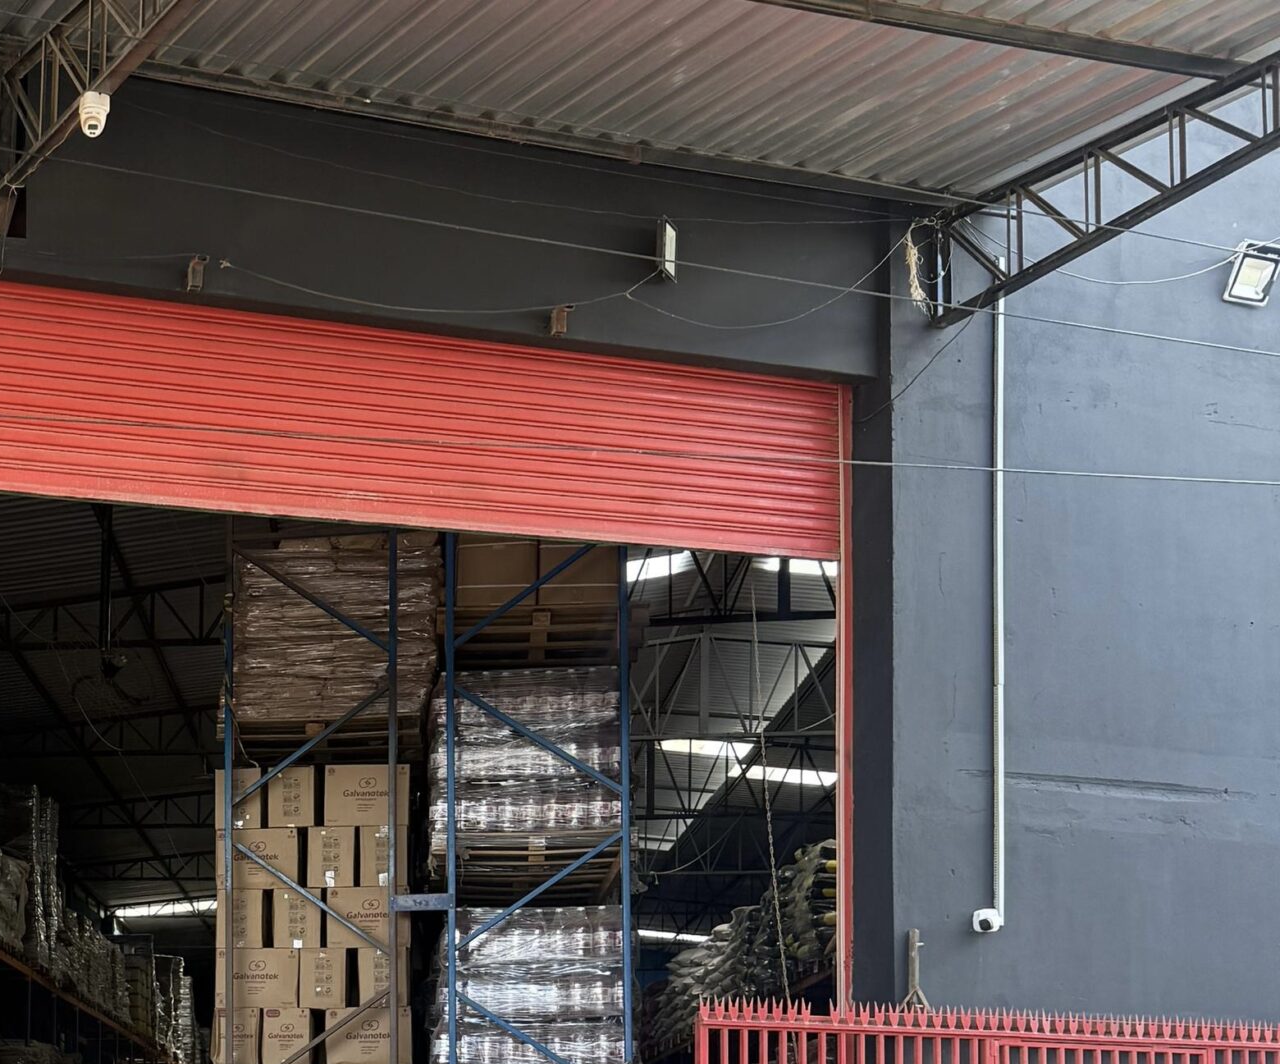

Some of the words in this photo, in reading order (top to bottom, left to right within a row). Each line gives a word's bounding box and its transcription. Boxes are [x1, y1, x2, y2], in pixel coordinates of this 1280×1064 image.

[234, 852, 279, 862] Galotek
[233, 972, 279, 980] Galvanotek
[268, 1032, 304, 1040] Galvanotek
